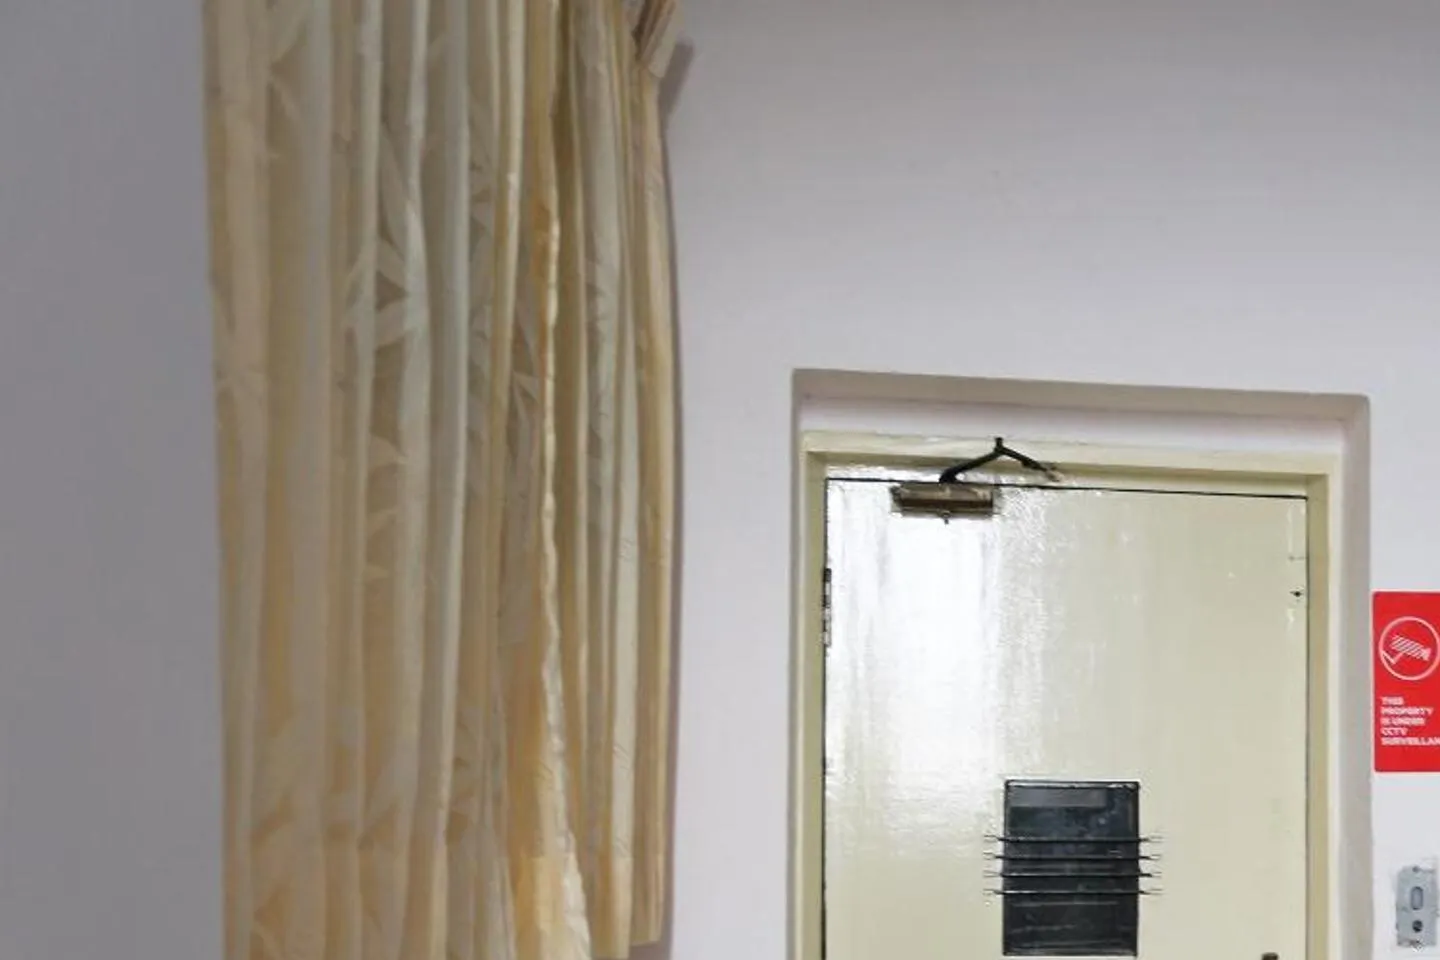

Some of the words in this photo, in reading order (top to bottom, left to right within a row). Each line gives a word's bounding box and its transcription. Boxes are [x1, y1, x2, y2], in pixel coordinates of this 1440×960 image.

[1381, 696, 1404, 705] THIS
[1381, 706, 1433, 716] PROPERTY
[1392, 717, 1425, 726] UNDER
[1381, 727, 1407, 736] CCTV
